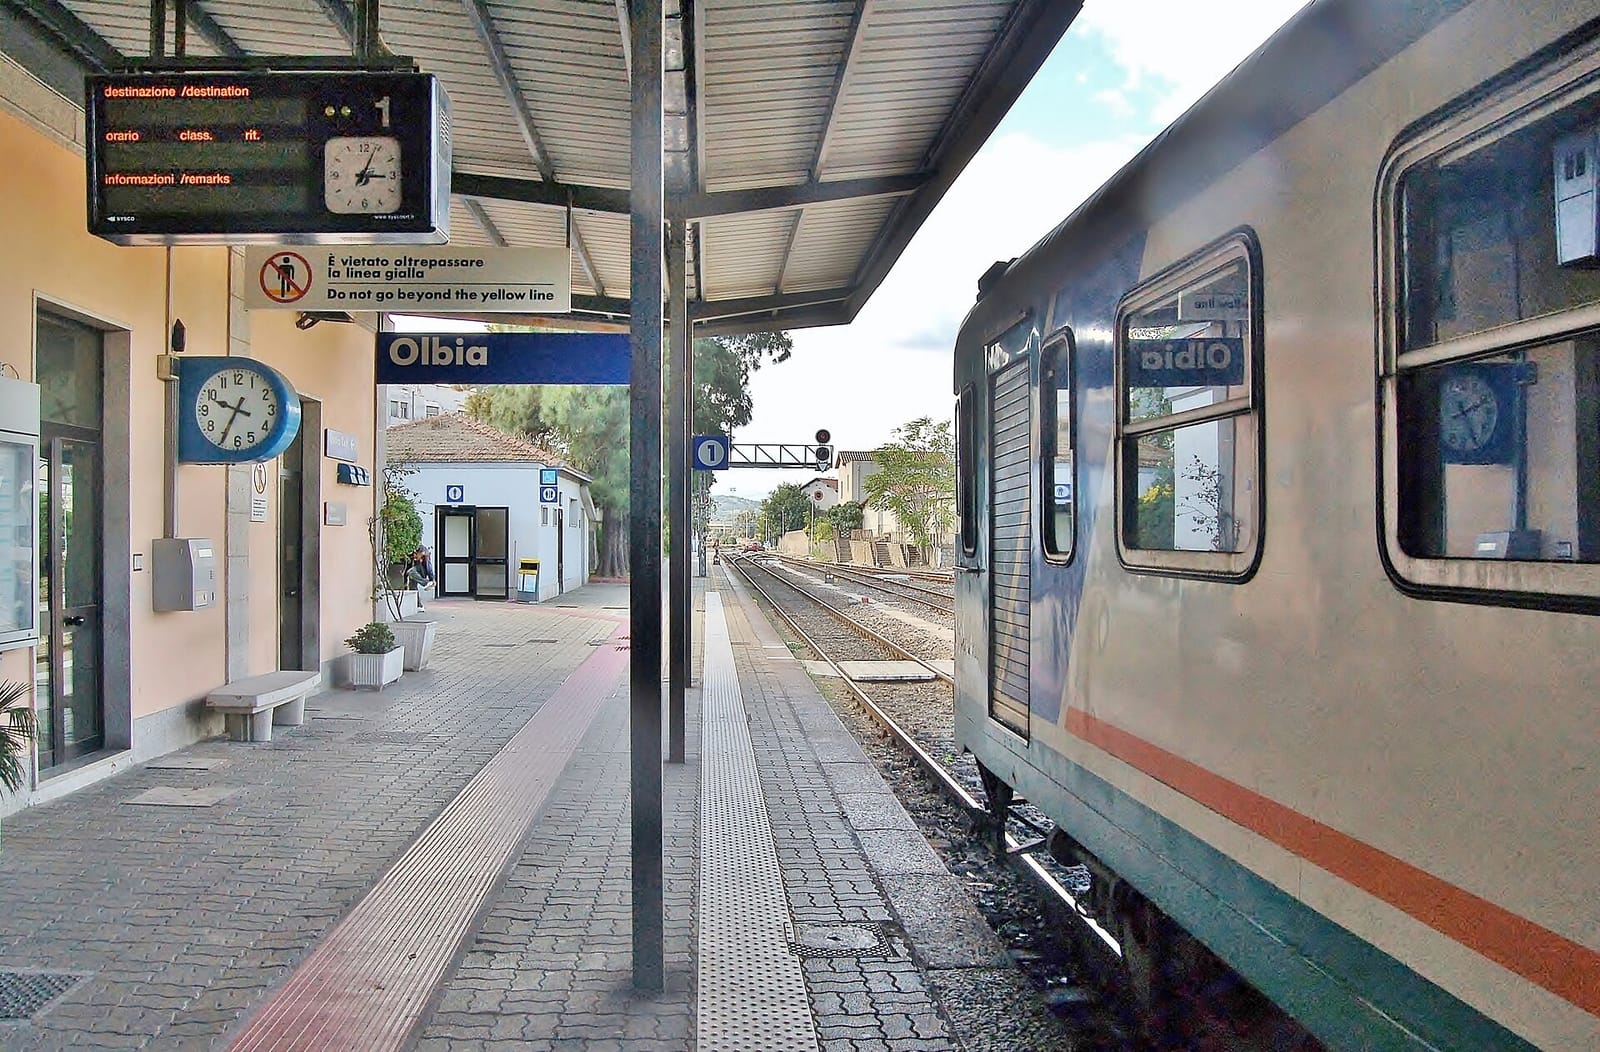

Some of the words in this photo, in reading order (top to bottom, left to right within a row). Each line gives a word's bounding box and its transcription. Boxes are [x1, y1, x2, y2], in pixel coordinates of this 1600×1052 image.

[104, 85, 176, 97] destinazione
[181, 85, 250, 97] /destination
[374, 96, 390, 128] 1
[105, 130, 140, 142] orario
[179, 129, 213, 141] class.
[244, 129, 261, 141] rit.
[359, 143, 370, 153] 12
[104, 173, 175, 185] informazioni
[180, 173, 231, 185] /remarks
[332, 170, 340, 180] 9
[389, 170, 397, 180] 3
[361, 198, 369, 208] 6
[327, 252, 336, 267] È
[340, 255, 389, 267] vietato
[394, 255, 484, 270] oltrepassare
[327, 267, 341, 279] la
[346, 267, 381, 279] linea
[385, 267, 425, 281] gialla
[327, 288, 346, 300] Do
[349, 289, 372, 300] not
[376, 290, 394, 302] go
[397, 288, 452, 302] beyond
[455, 288, 478, 300] the
[481, 288, 526, 303] yellow
[529, 288, 555, 301] line
[389, 336, 488, 366] Olbia
[220, 376, 227, 389] 11
[233, 373, 244, 386] 12
[207, 389, 217, 401] 10
[262, 388, 269, 401] 2
[201, 404, 209, 416] 9
[267, 404, 275, 416] 3
[207, 420, 214, 431] 8
[261, 420, 269, 432] 4
[233, 435, 242, 447] 6
[247, 431, 255, 443] 5
[707, 444, 715, 462] 1
